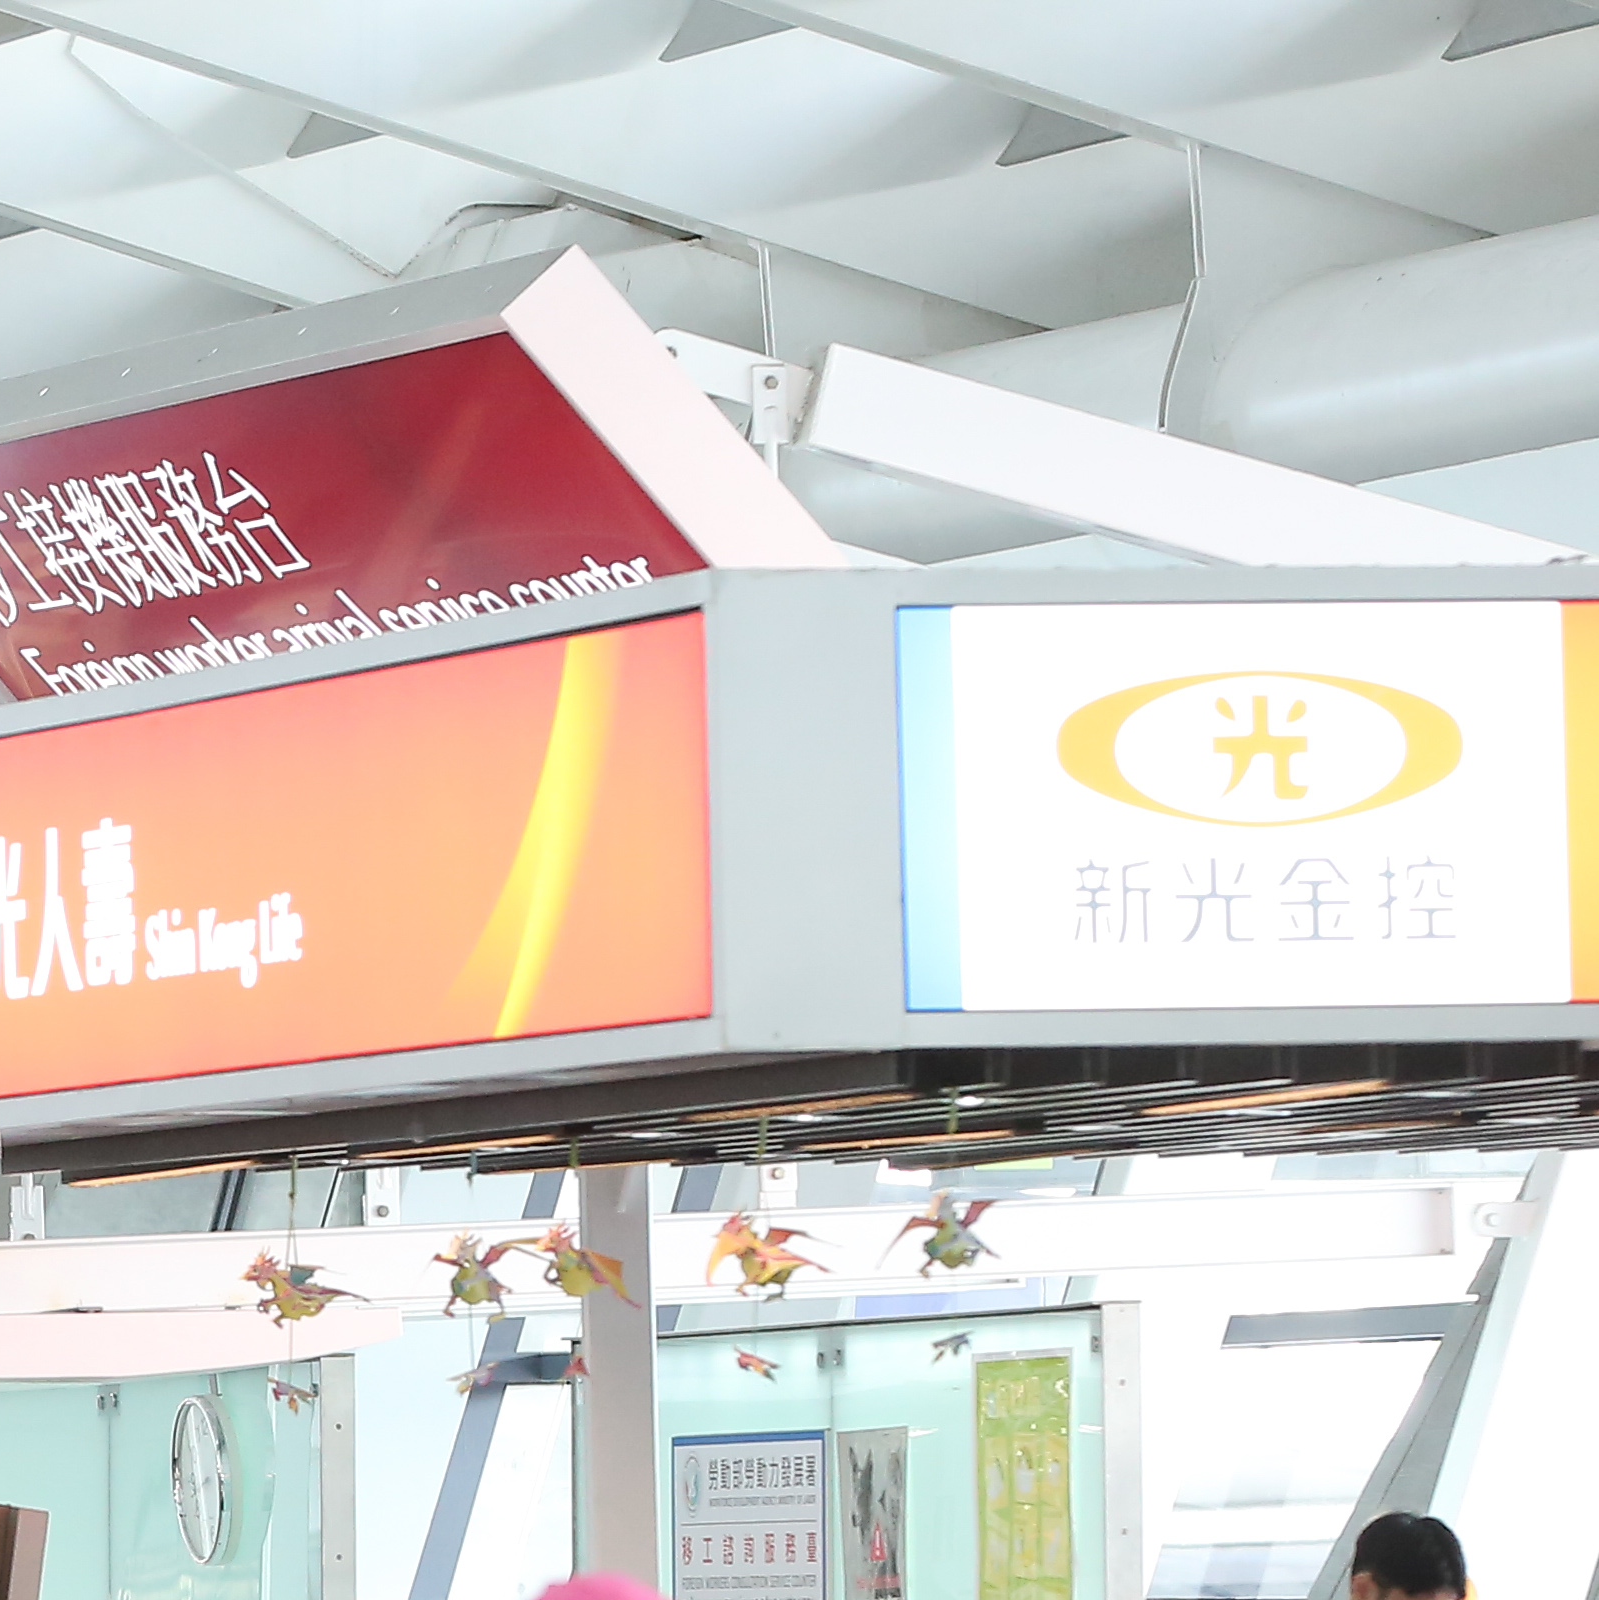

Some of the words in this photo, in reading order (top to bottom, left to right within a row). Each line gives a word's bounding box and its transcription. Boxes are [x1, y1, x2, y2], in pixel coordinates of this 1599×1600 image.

[1212, 694, 1310, 800] 光
[1074, 855, 1457, 943] 新光金控
